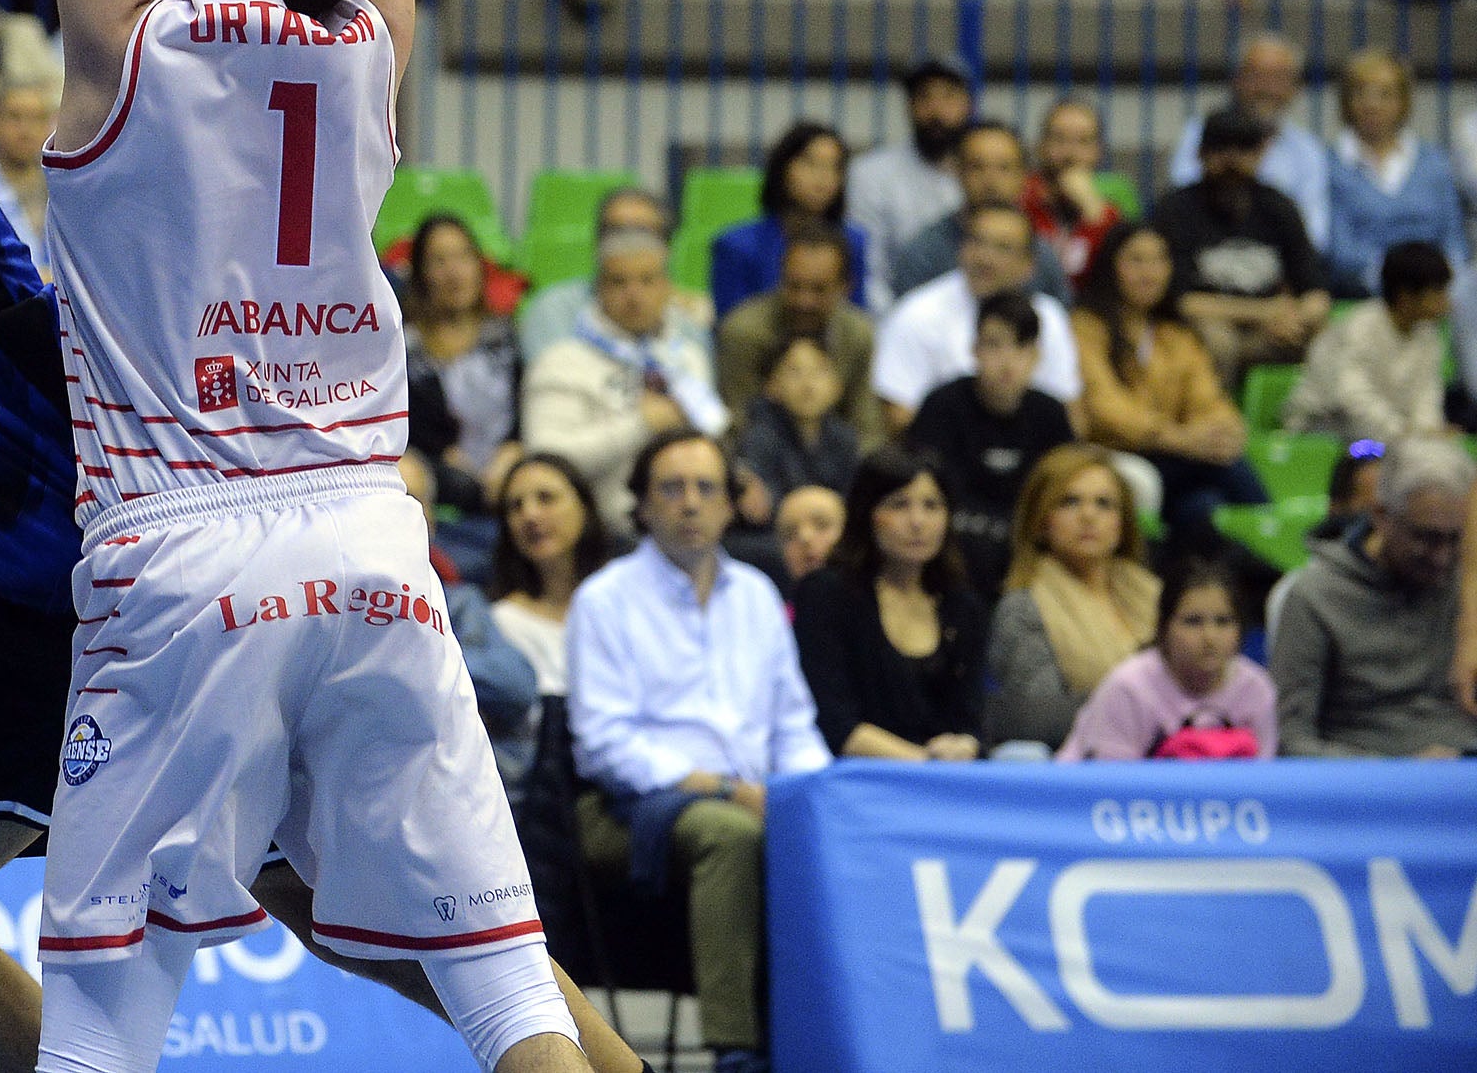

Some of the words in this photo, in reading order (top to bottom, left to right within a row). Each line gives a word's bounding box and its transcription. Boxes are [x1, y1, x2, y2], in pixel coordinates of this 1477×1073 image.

[267, 79, 318, 267] 1
[246, 360, 323, 383] XUNTA
[246, 384, 276, 405] DE
[276, 378, 380, 409] GALICIA
[216, 593, 292, 634] La
[298, 578, 445, 637] Región
[1090, 798, 1272, 846] GRUPO
[468, 887, 511, 907] MORA
[164, 1009, 327, 1058] SALUD
